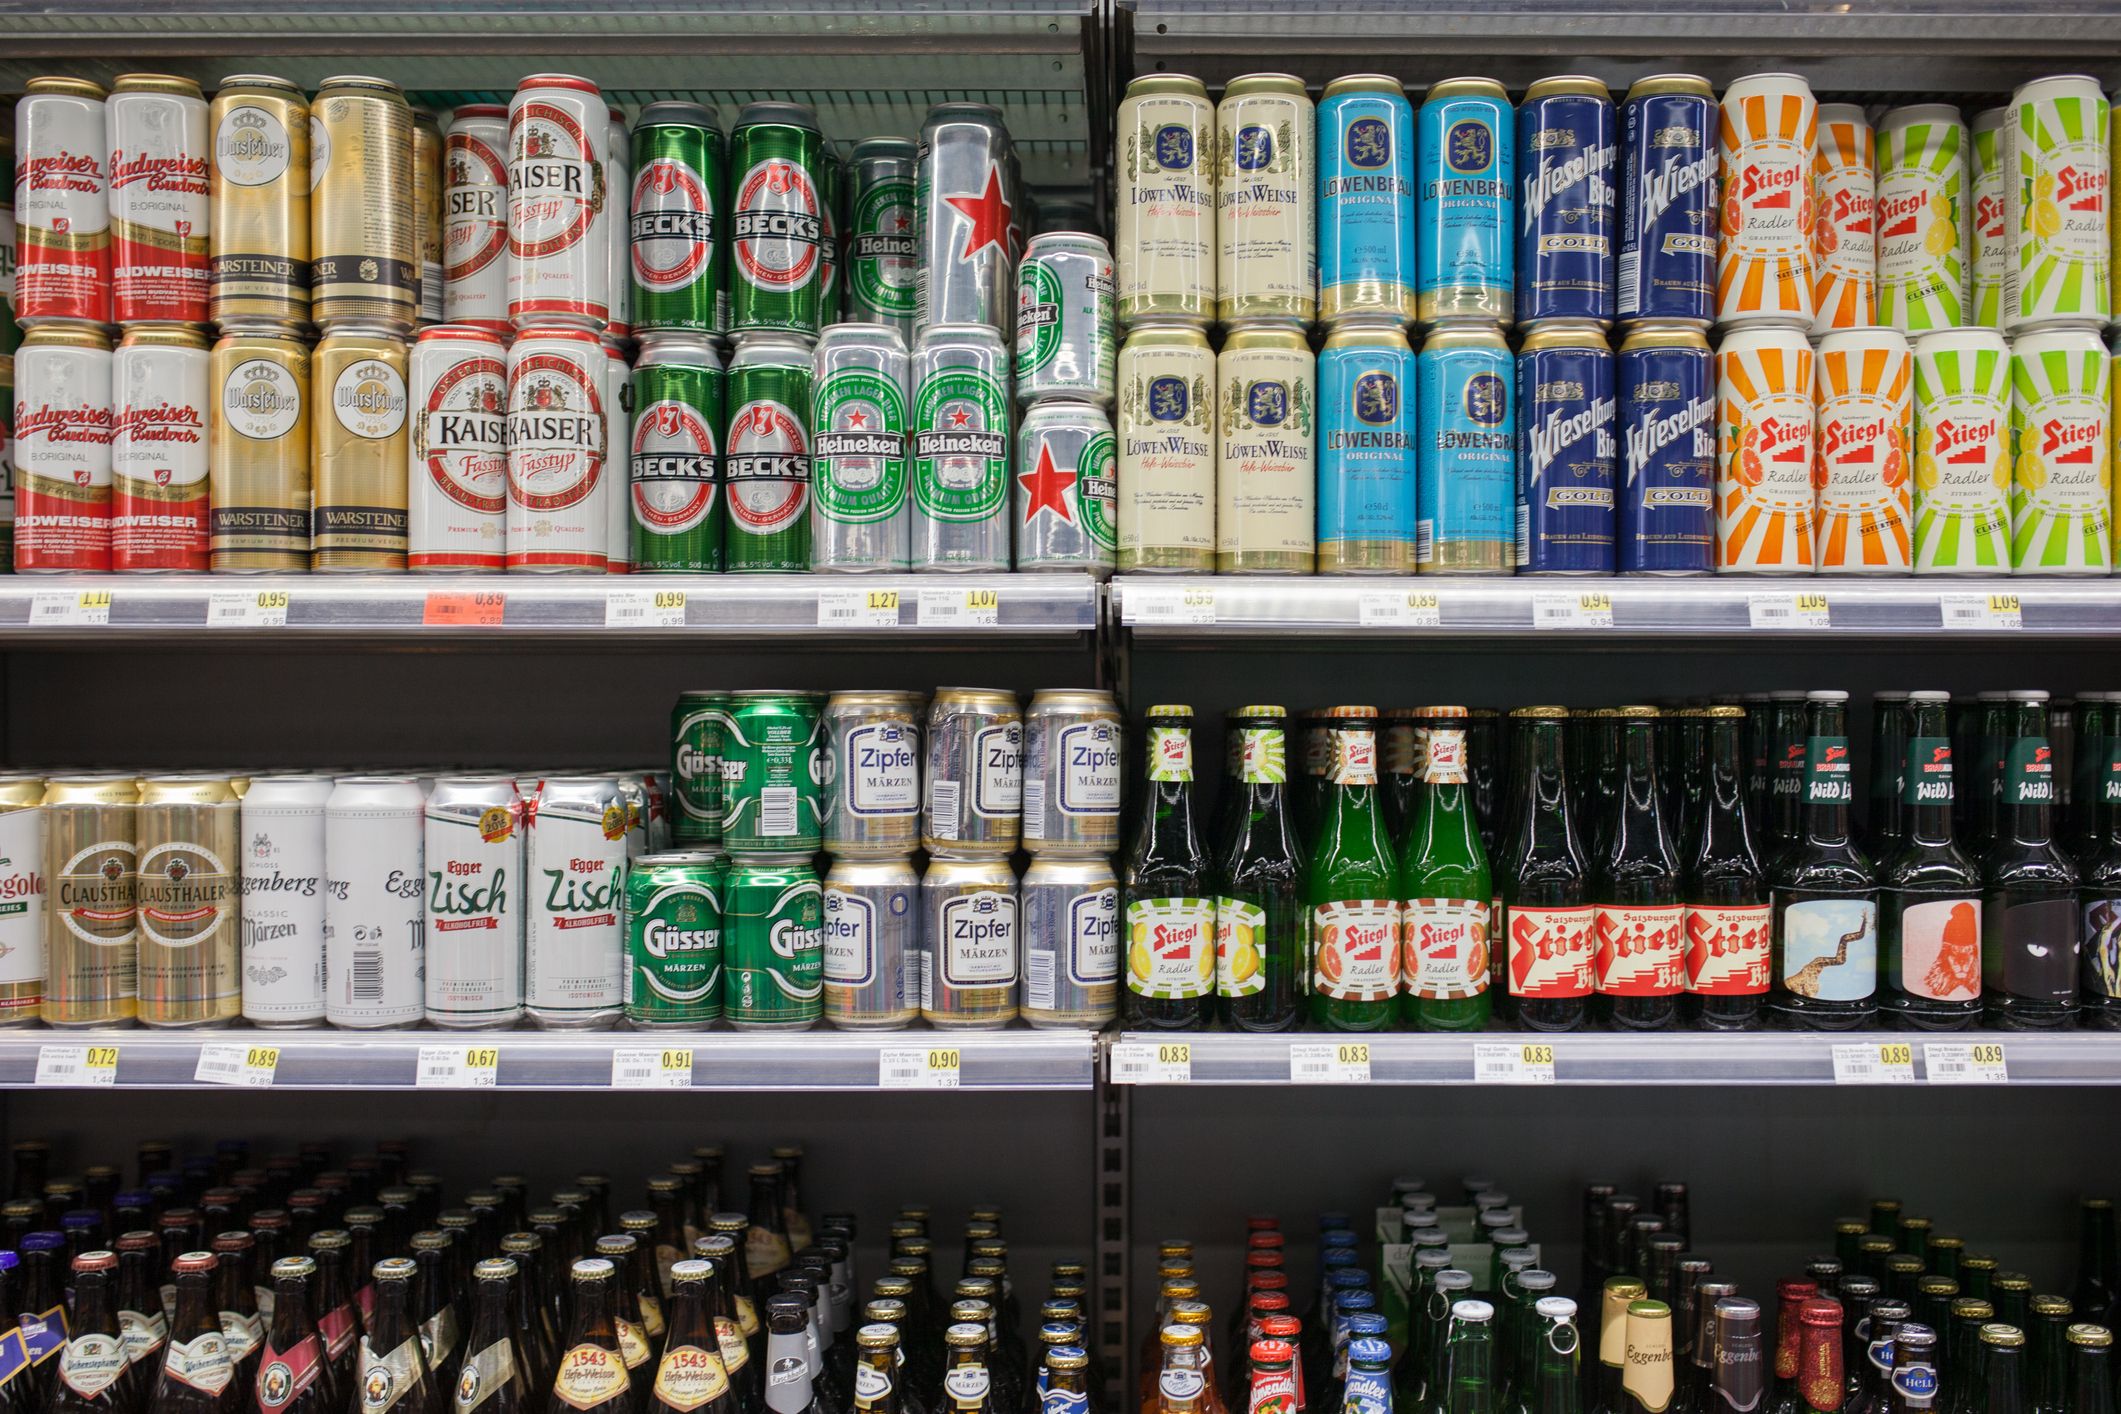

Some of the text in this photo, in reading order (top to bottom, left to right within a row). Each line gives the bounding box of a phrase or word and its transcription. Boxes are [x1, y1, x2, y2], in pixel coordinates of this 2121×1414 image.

[1742, 163, 1800, 201] Stiegl
[2057, 164, 2108, 203] Stiegl
[1834, 187, 1874, 223] Stieg
[1877, 189, 1927, 230] Stiegl
[632, 212, 711, 237] BECK'S
[736, 213, 819, 239] BECK'S
[1747, 214, 1795, 231] Radler
[1546, 237, 1606, 250] GOLD
[1881, 240, 1922, 259] Radler
[1907, 283, 1948, 302] CLASSIC
[227, 382, 296, 412] Warsteiner
[337, 382, 404, 412] Warsteiner
[508, 417, 594, 446] KAISER
[1760, 416, 1811, 454] Stiegl
[1825, 417, 1885, 457] Stiegl
[1935, 417, 1996, 457] Stiegl
[2042, 417, 2101, 457] Stiegl
[816, 436, 902, 456] Heineken
[918, 434, 1003, 456] Heineken
[1126, 436, 1209, 457] LÖWENWEISSE
[1225, 439, 1309, 461] LÖWENWEISSE
[519, 452, 575, 479] Fasstyp
[632, 455, 715, 478] BECK'S
[726, 455, 809, 478] BECK'S
[1767, 469, 1808, 484] Radler
[1831, 471, 1879, 486] Radler
[1942, 471, 1991, 486] Radler
[2050, 470, 2098, 486] Radler
[1555, 490, 1612, 502] GOLD
[1652, 490, 1709, 502] GOLD
[218, 511, 306, 530] WARSTEINER
[258, 592, 286, 608] 0,95
[655, 593, 684, 609] 0,99
[869, 593, 898, 609] 1,27
[970, 592, 997, 608] 1,07
[1581, 594, 1609, 610] 0,94
[1801, 594, 1826, 610] 1,09
[1992, 594, 2019, 611] 1,09
[859, 746, 916, 774] Zipfer
[866, 777, 913, 789] MÄRZEN
[1808, 780, 1840, 801] Wild
[1916, 780, 1947, 801] Wild
[2018, 780, 2050, 801] Wild
[447, 860, 483, 876] Egger
[570, 857, 605, 873] Egger
[139, 882, 226, 905] CLAUSTHALER
[428, 867, 506, 916] Zisch
[543, 865, 623, 914] Zisch
[1623, 912, 1677, 924] Salzburger
[1717, 912, 1767, 924] Salzburger
[643, 917, 721, 959] Gösser
[953, 919, 1012, 945] Zipfer
[1153, 924, 1198, 952] Stiegl
[1344, 923, 1389, 955] Stiegl
[1420, 923, 1465, 953] Stiegl
[959, 947, 1009, 960] MÄRZEN
[663, 962, 707, 974] MÄRZEN
[1158, 963, 1194, 975] Radler
[1349, 964, 1385, 976] Radler
[1424, 963, 1459, 975] Radler
[87, 1049, 115, 1065] 0,72
[247, 1051, 275, 1067] 0,89
[467, 1050, 496, 1067] 0,67
[662, 1050, 690, 1067] 0,91
[929, 1051, 958, 1067] 0,90
[1160, 1046, 1187, 1063] 0,83
[1339, 1046, 1367, 1064] 0,83
[1524, 1046, 1552, 1064] 0,83
[1881, 1047, 1910, 1064] 0,89
[1974, 1046, 2003, 1064] 0,89
[572, 1351, 608, 1368] 1543
[672, 1352, 708, 1370] 1543
[563, 1368, 616, 1385] Hefe-Weisse
[664, 1369, 716, 1386] Hefe-Weisse
[955, 1380, 984, 1390] MÄRZEN
